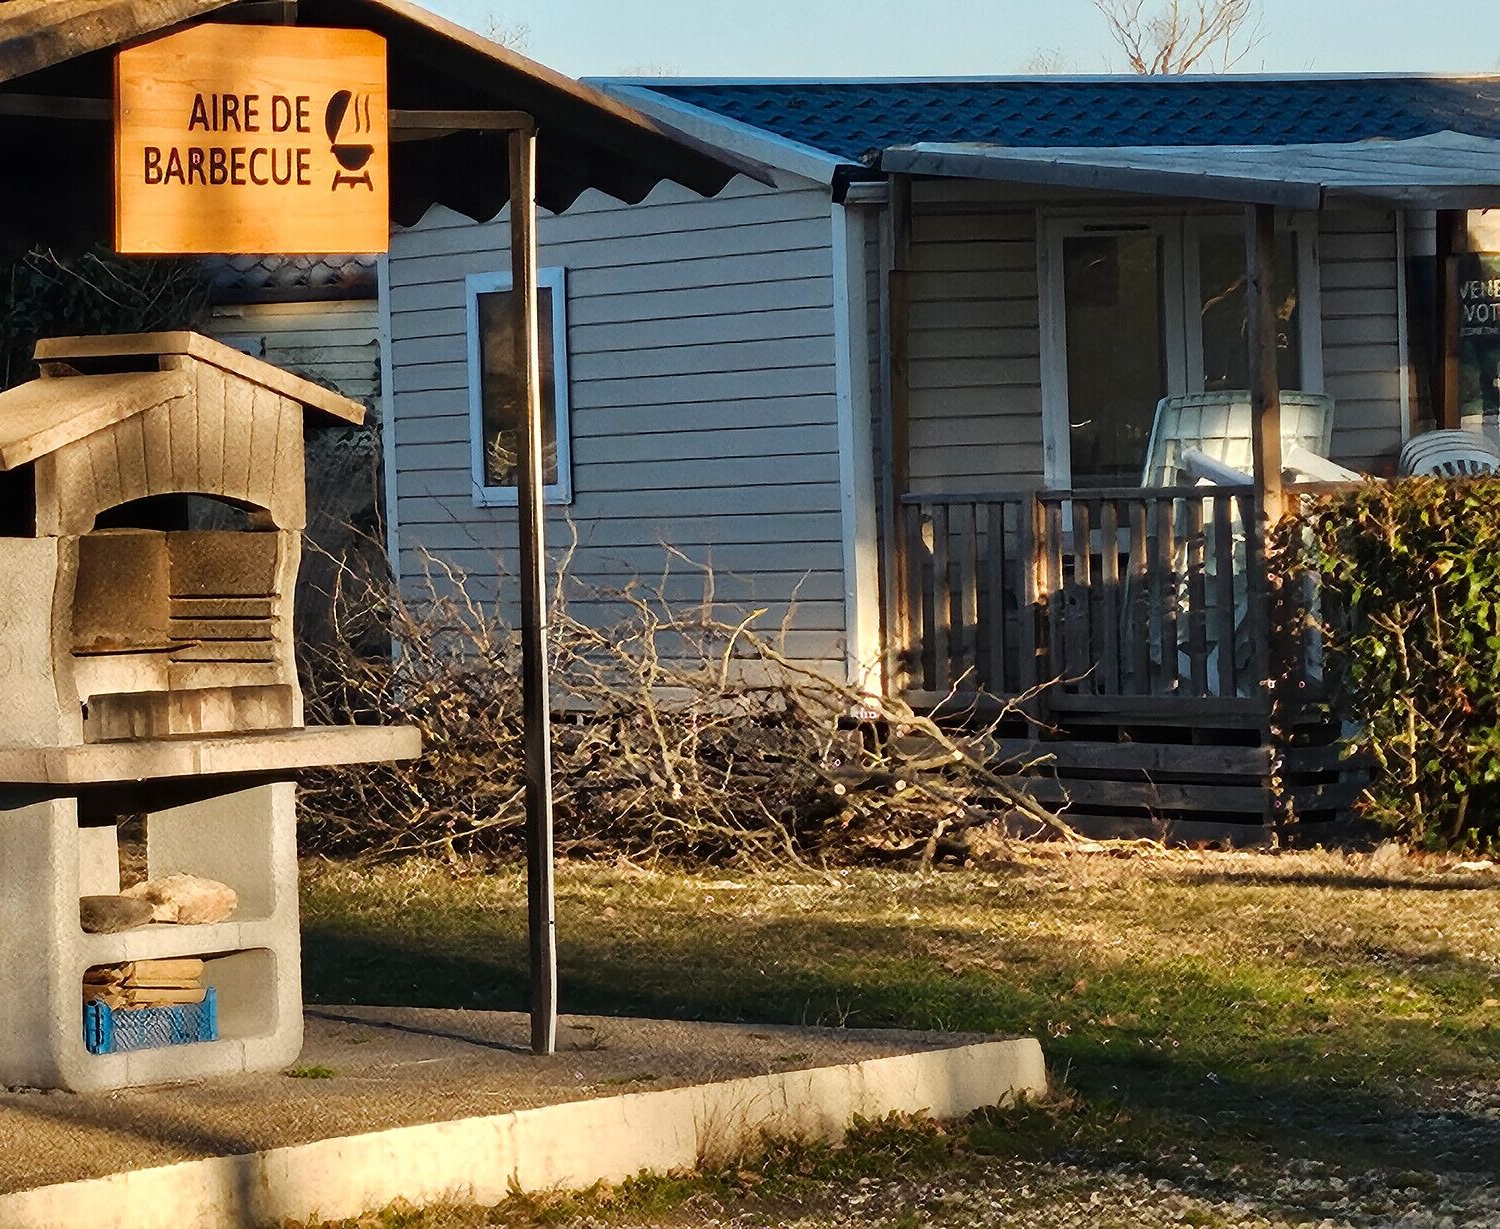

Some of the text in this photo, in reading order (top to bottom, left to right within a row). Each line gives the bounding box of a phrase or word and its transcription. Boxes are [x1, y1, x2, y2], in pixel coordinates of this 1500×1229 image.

[188, 93, 311, 133] AIRE DE
[144, 146, 312, 186] BARBECUE
